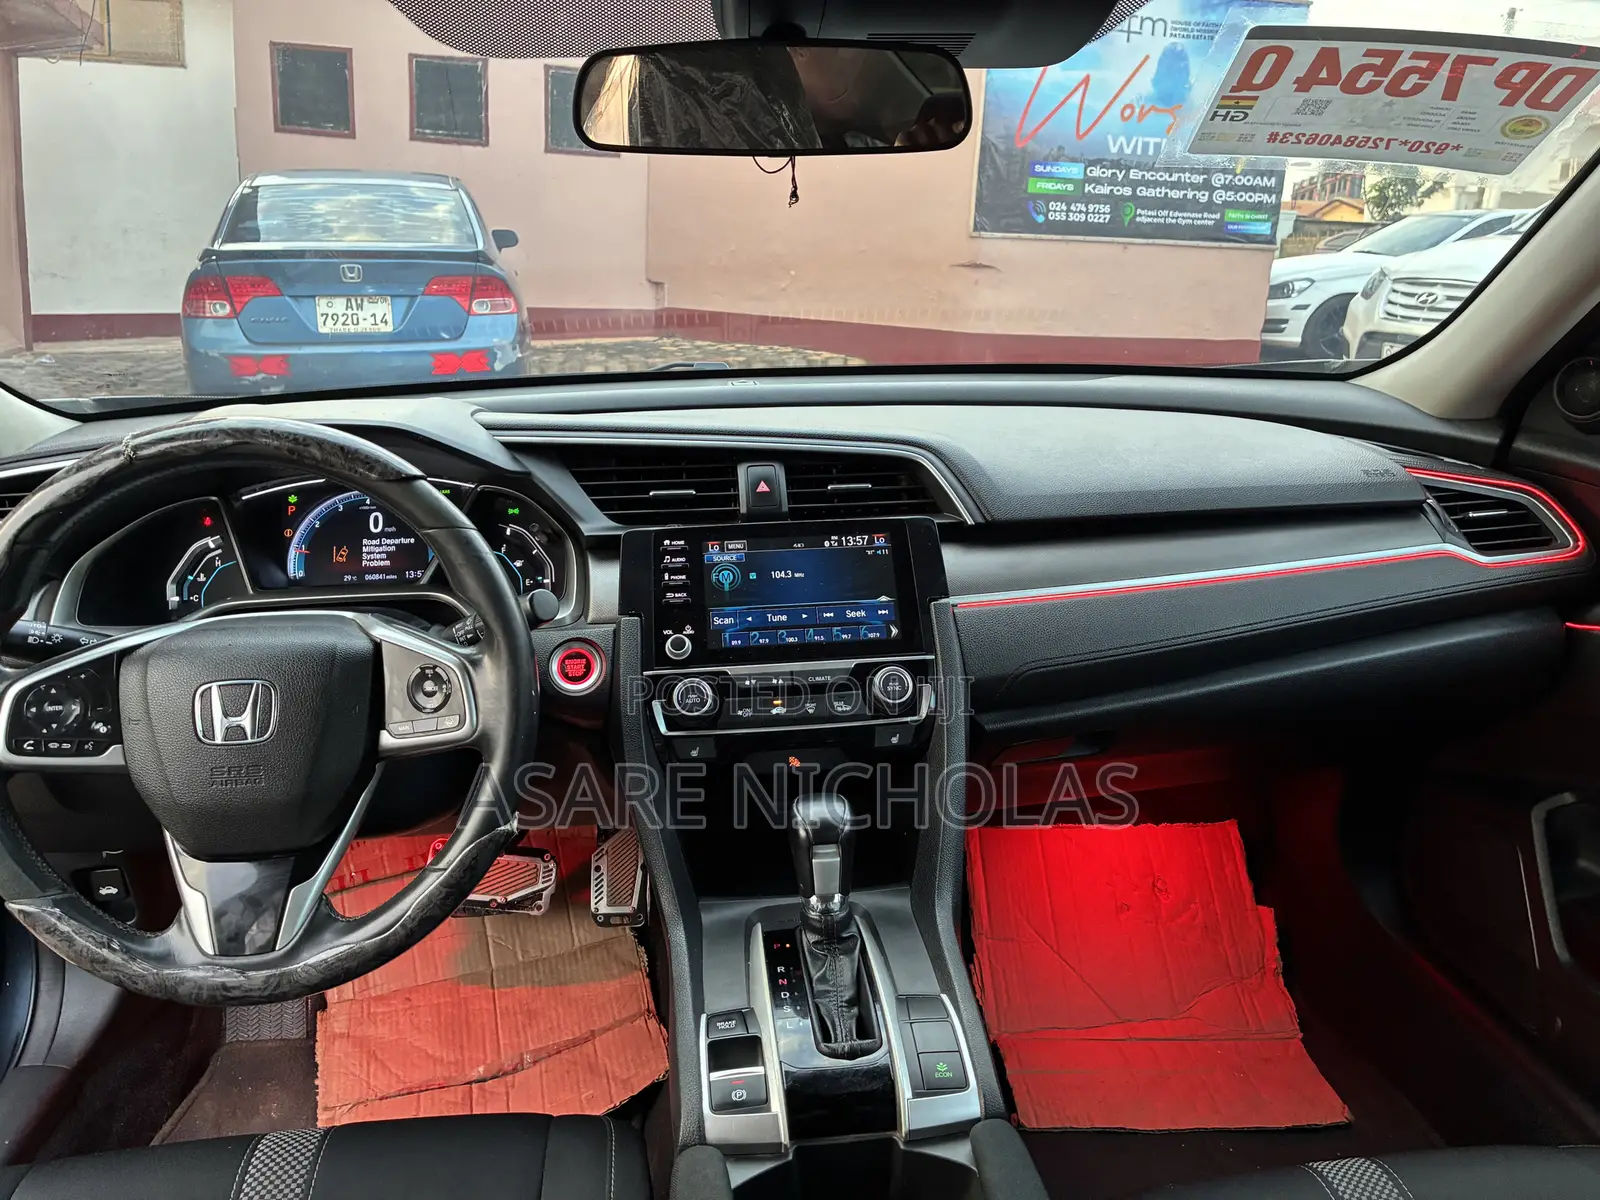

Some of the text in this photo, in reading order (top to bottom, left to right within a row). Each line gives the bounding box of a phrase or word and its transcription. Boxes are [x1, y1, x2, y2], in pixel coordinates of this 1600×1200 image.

[1034, 164, 1276, 188] SUNDAYS Glory Encounter @7:00AM
[1036, 182, 1276, 204] FRIDAYS Kairos Gathering @5:00PM
[1049, 201, 1111, 213] 024 474 9756
[1048, 211, 1111, 223] 055 309 0227
[1136, 215, 1164, 224] adjacent
[1166, 216, 1177, 224] the
[1194, 218, 1215, 226] center
[1203, 212, 1220, 220] Road
[345, 297, 364, 311] AW
[321, 313, 389, 326] 7920-14
[288, 506, 296, 515] P
[369, 512, 384, 533] 0
[362, 537, 415, 546] Road Departure
[709, 543, 719, 552] Lo
[841, 535, 869, 546] 13:57
[874, 536, 885, 544] Lo
[362, 545, 396, 554] Mitigation
[362, 552, 387, 561] System
[713, 554, 737, 562] SOURCE
[362, 560, 391, 568] Problem
[405, 570, 425, 579] 13:5
[771, 570, 792, 579] 104.3
[767, 613, 787, 622] Tune
[846, 609, 867, 618] Seek
[713, 616, 735, 625] Scan
[781, 991, 789, 999] D
[783, 1005, 791, 1013] S
